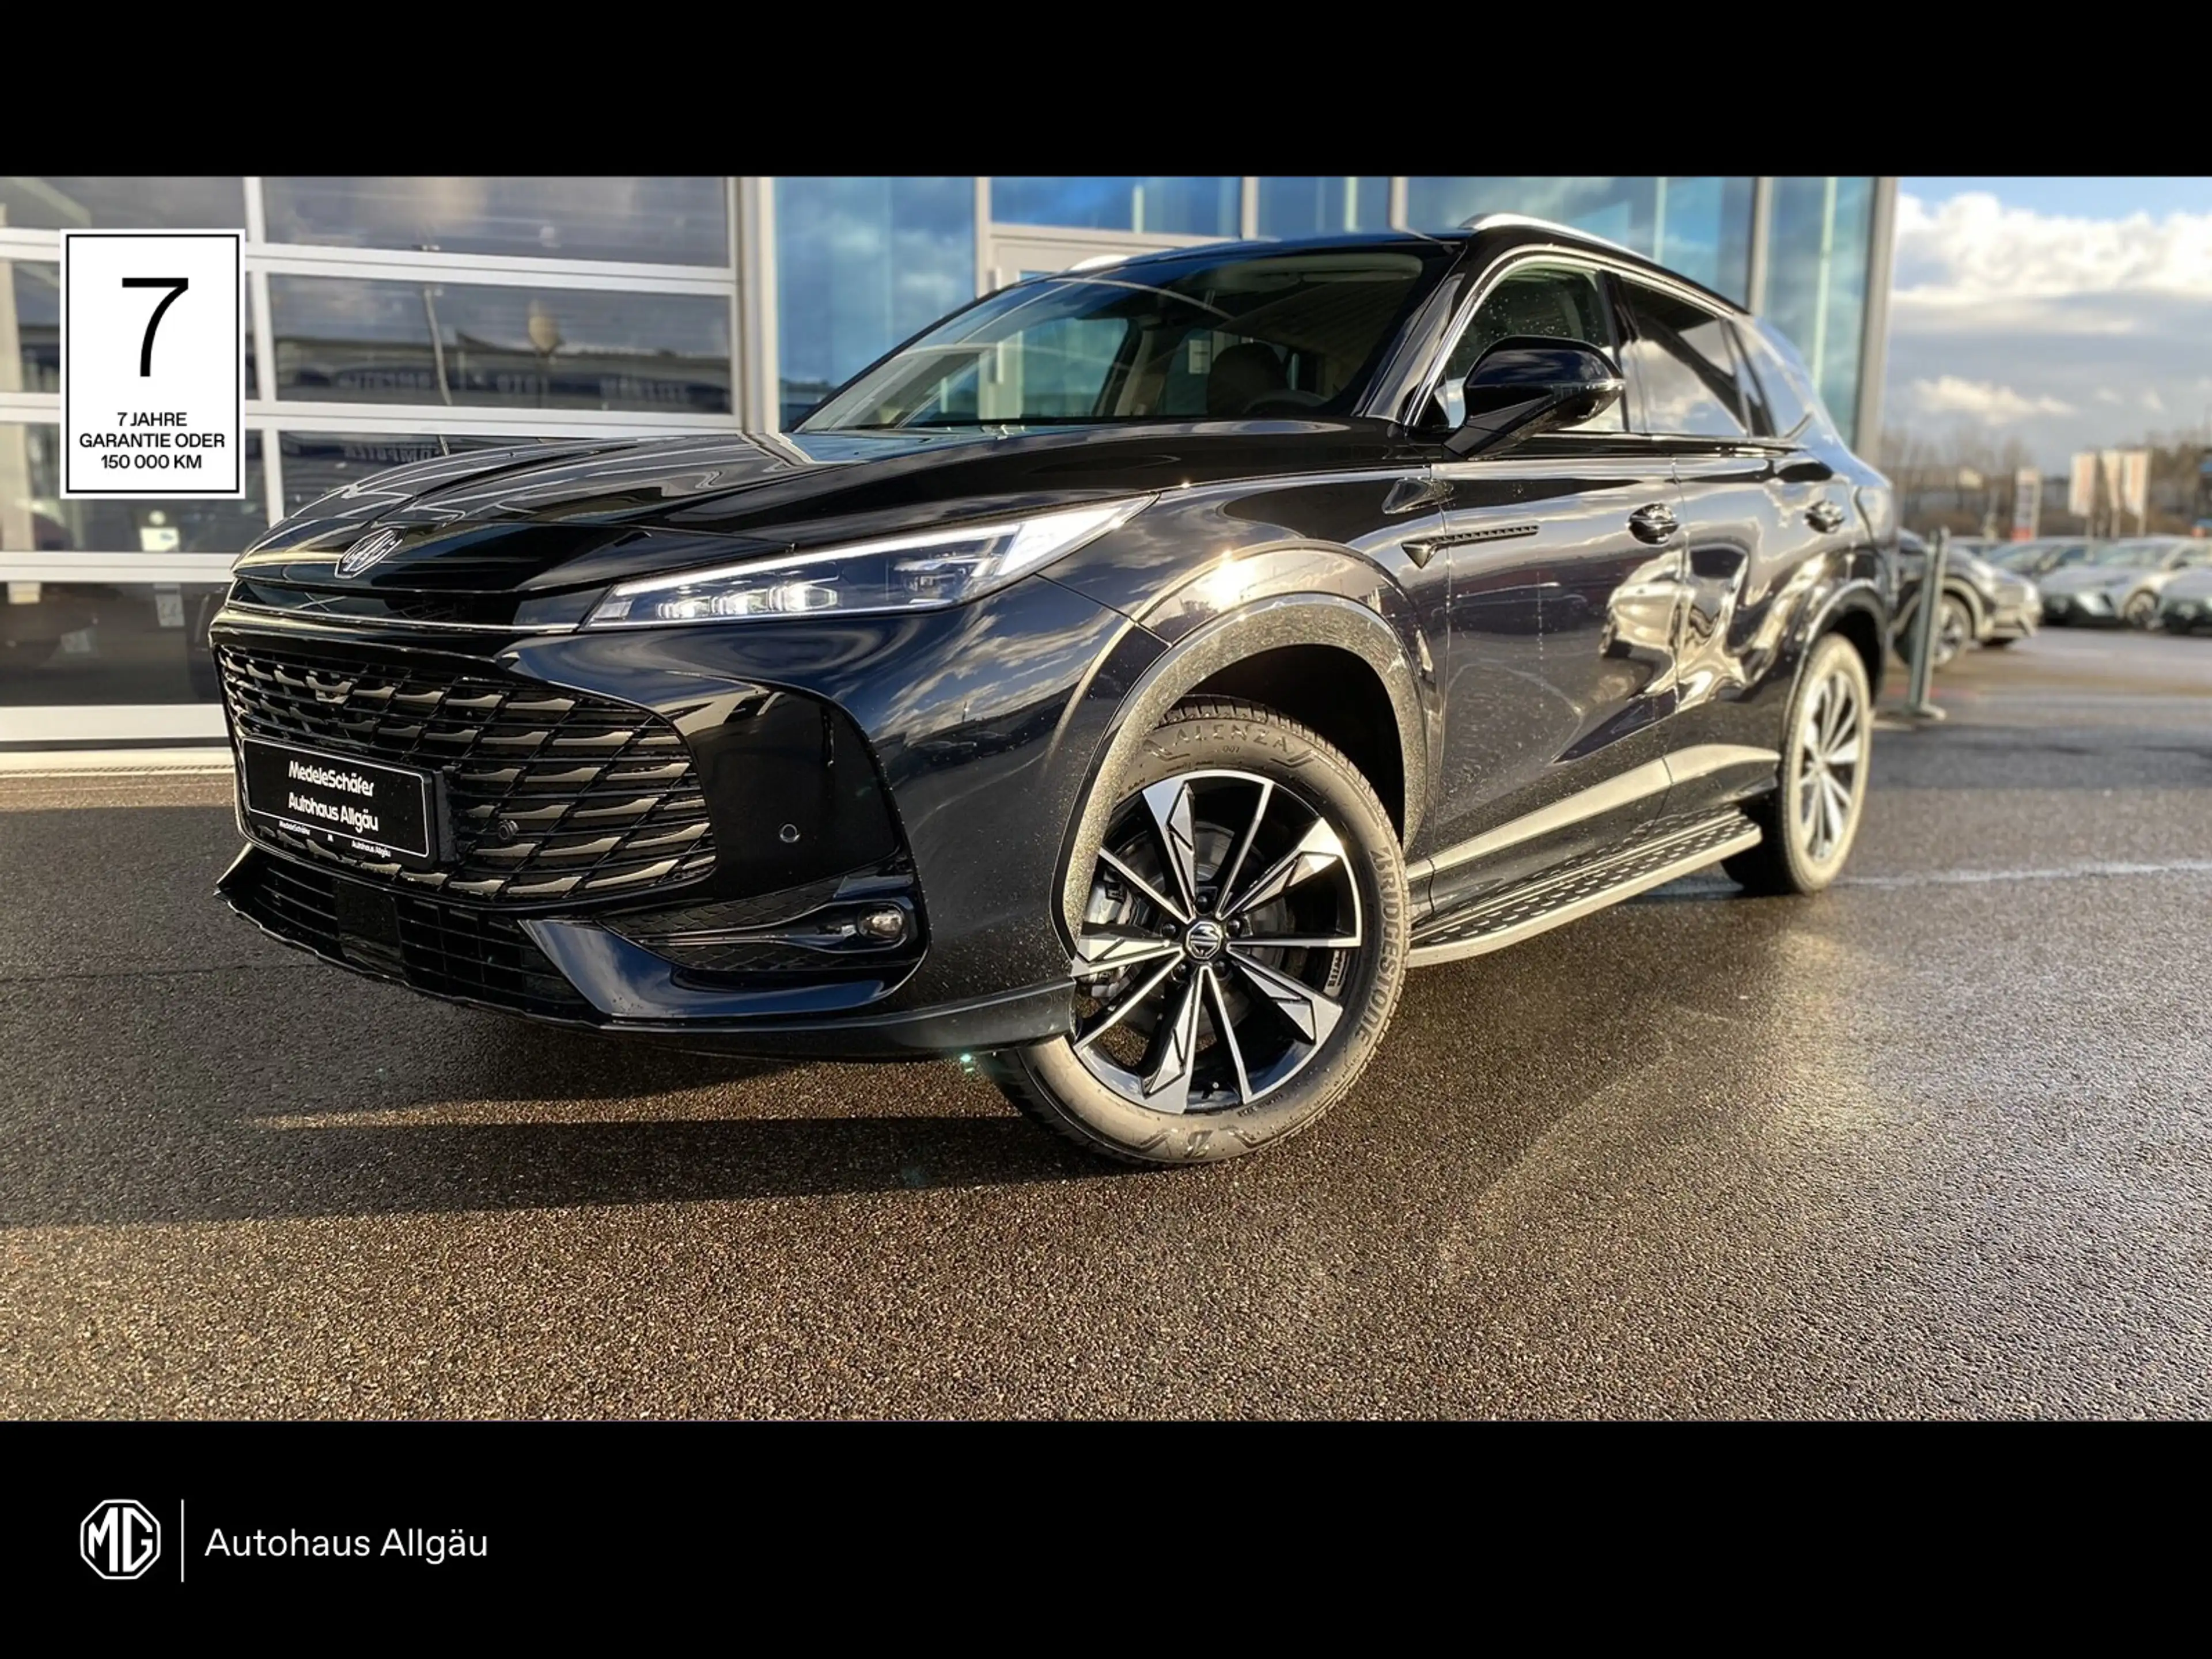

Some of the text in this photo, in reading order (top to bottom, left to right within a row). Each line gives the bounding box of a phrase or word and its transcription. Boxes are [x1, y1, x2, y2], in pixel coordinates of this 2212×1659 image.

[1173, 724, 1290, 753] ALENZA
[289, 760, 374, 797] MedeleSchäfer
[288, 791, 379, 834] Autohaus Allgäu
[1355, 846, 1400, 1047] BRIDGESTONE
